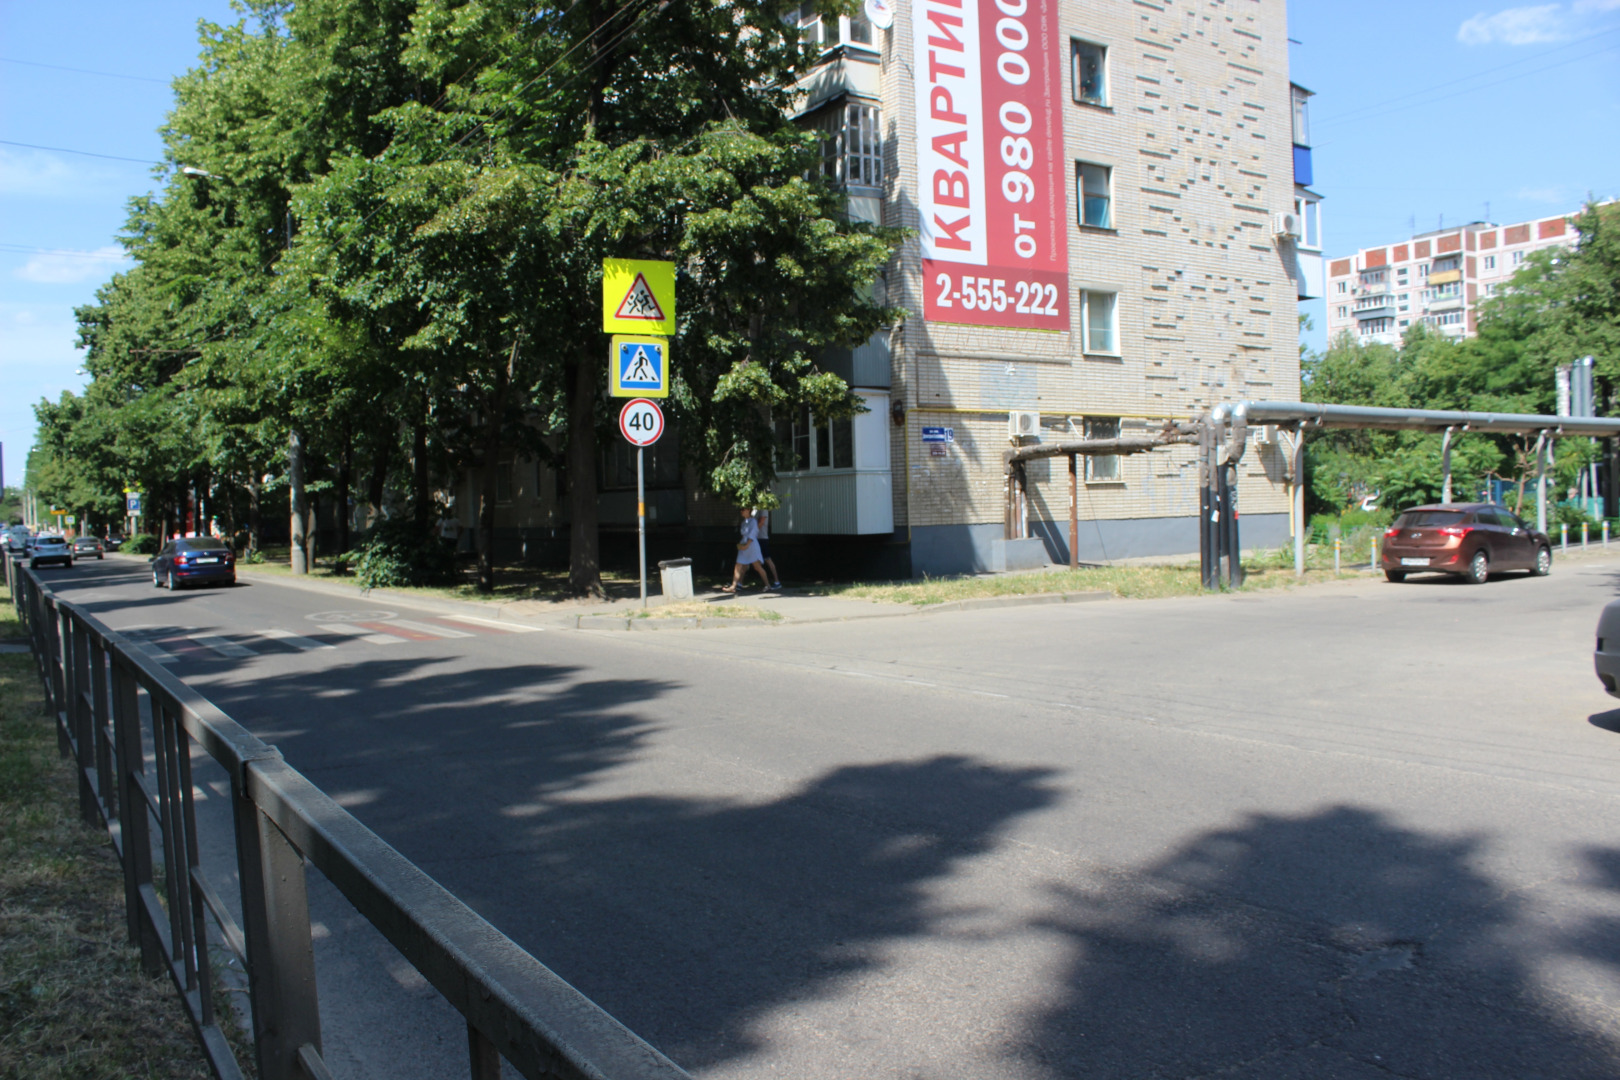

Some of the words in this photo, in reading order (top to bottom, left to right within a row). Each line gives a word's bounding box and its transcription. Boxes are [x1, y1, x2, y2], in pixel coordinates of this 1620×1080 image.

[926, 0, 972, 252] КВАРТИ
[998, 101, 1035, 203] 980
[1013, 213, 1037, 259] от
[936, 273, 1059, 316] 2-555-222
[629, 412, 653, 431] 40
